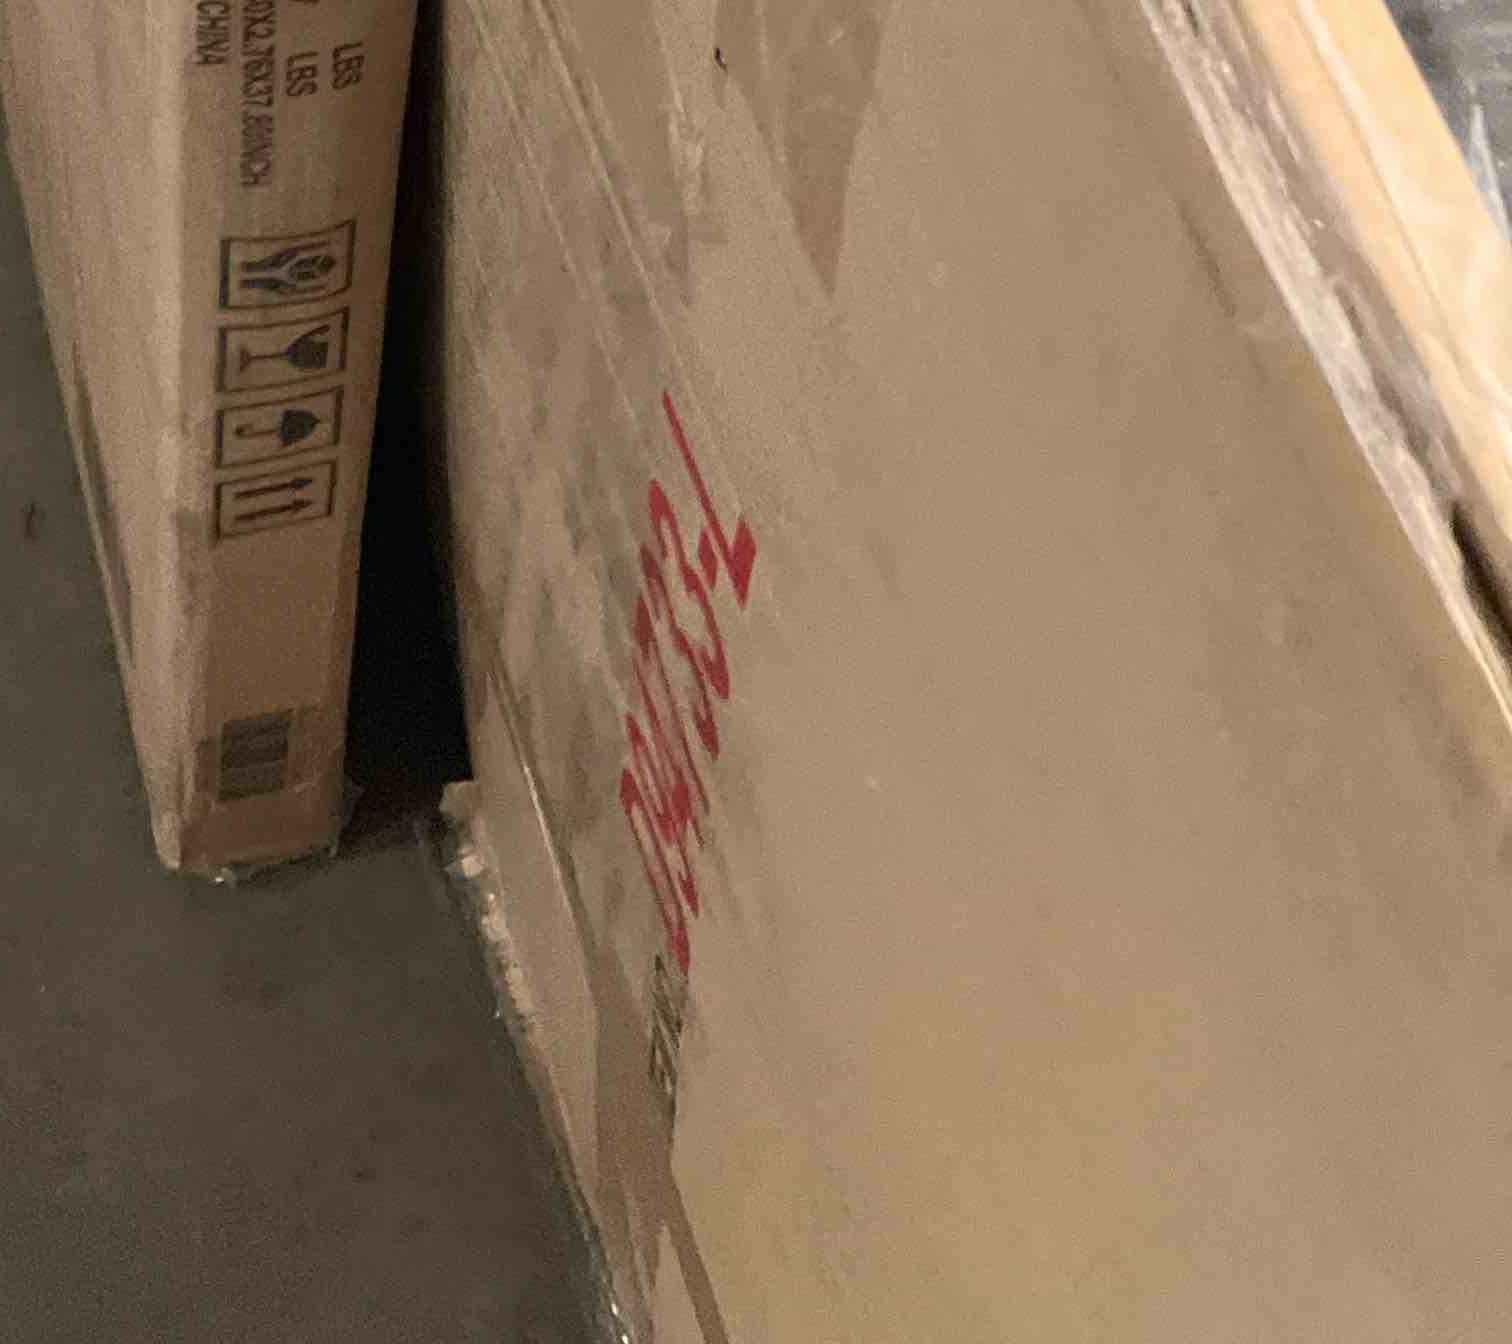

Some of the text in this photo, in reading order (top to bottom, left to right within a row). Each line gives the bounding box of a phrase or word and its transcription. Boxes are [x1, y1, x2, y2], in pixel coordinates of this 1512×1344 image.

[194, 0, 232, 67] CHINA
[285, 50, 319, 98] LBS
[331, 41, 365, 91] LBS
